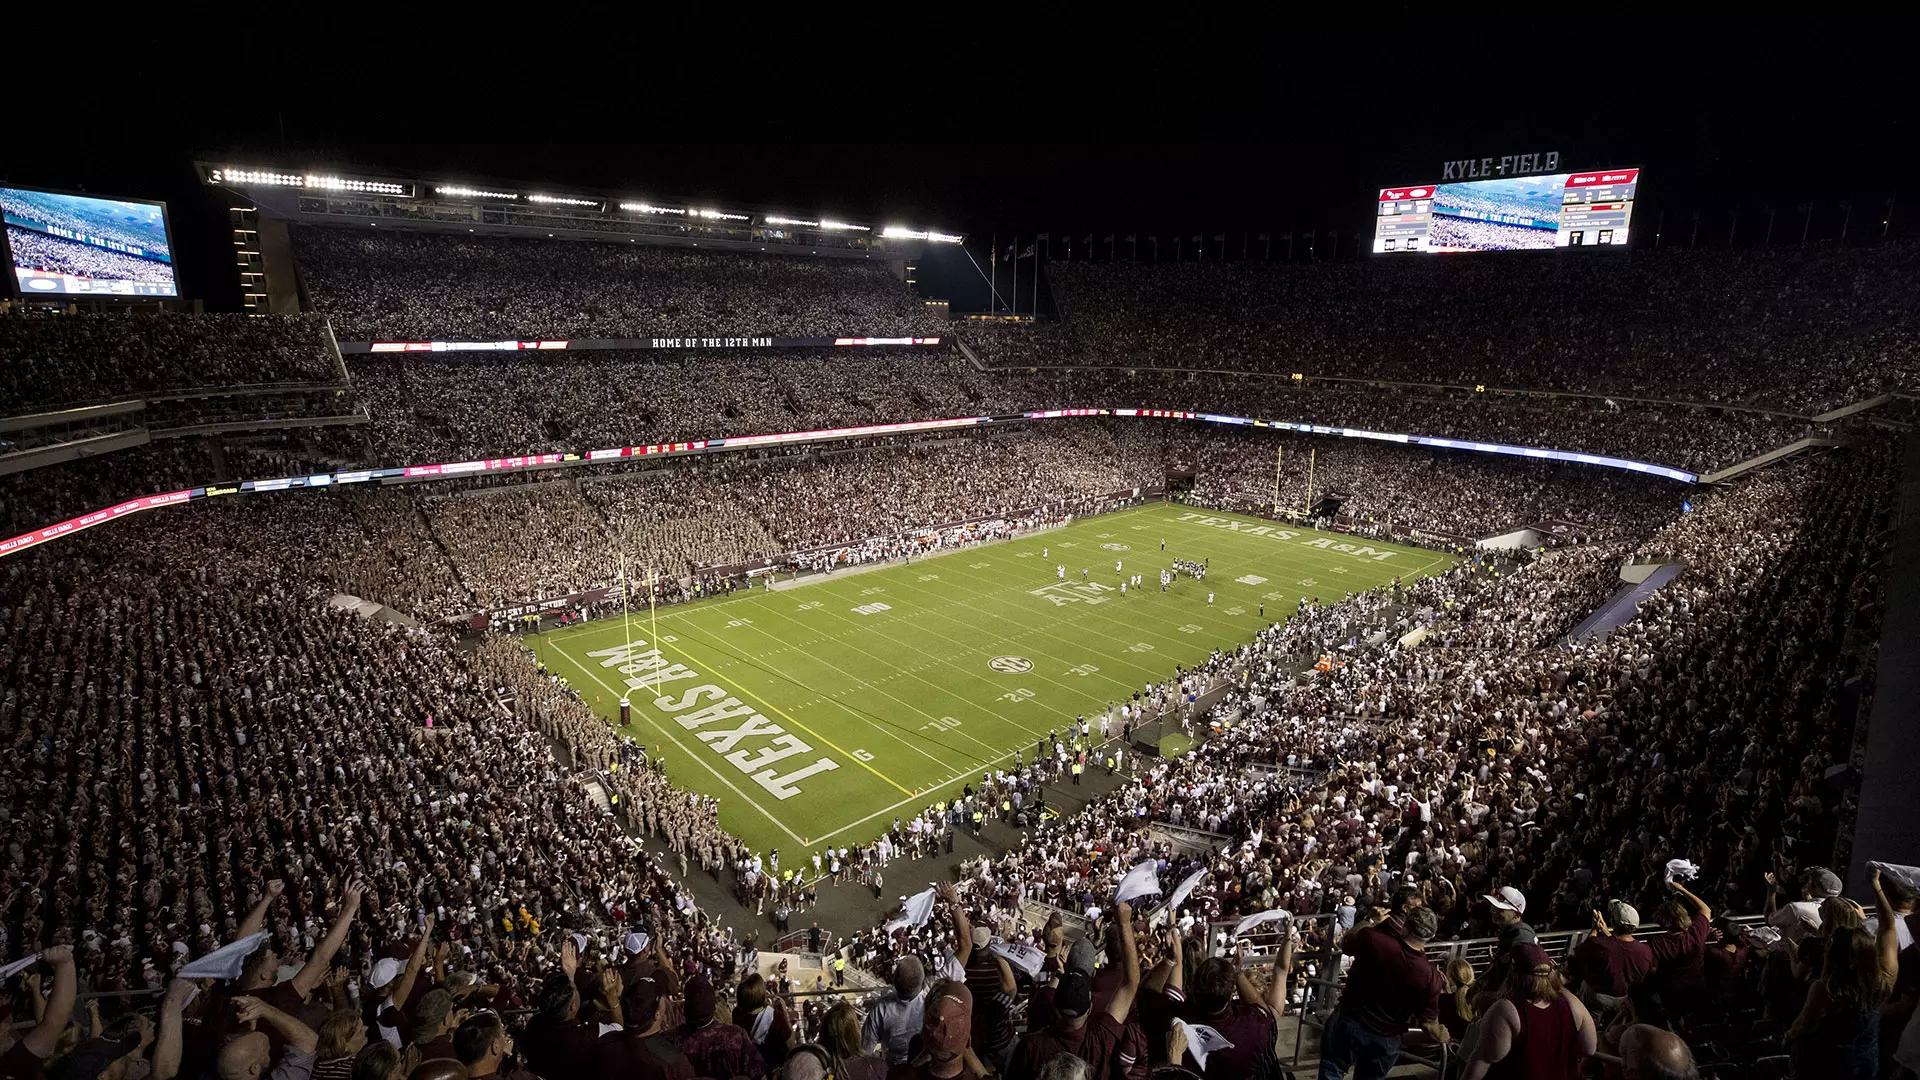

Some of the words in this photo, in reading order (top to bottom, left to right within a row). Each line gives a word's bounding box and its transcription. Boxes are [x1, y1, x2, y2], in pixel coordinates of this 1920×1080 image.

[1442, 158, 1493, 180] KYLE
[1499, 151, 1559, 175] FIELD
[652, 338, 681, 348] HOME
[685, 338, 697, 347] OF
[702, 338, 721, 347] THE
[725, 338, 748, 347] 12TH
[752, 338, 772, 347] MAN
[149, 496, 169, 504] WELLS
[80, 516, 95, 525] WELLS
[94, 512, 107, 521] FARGO
[42, 528, 58, 537] WELLS
[58, 523, 73, 532] FARGO
[1176, 512, 1301, 541] TEXAS
[1301, 537, 1398, 561] A&M
[0, 541, 17, 551] WELLS
[18, 536, 34, 545] FARGO
[797, 601, 824, 611] 20
[727, 618, 754, 628] 10
[1178, 624, 1204, 634] 50
[1128, 642, 1155, 653] 40
[585, 639, 700, 690] A&M
[1069, 664, 1099, 676] 30
[1002, 688, 1036, 703] 20
[928, 716, 962, 732] 10
[652, 684, 841, 800] TEXAS
[852, 749, 875, 762] G
